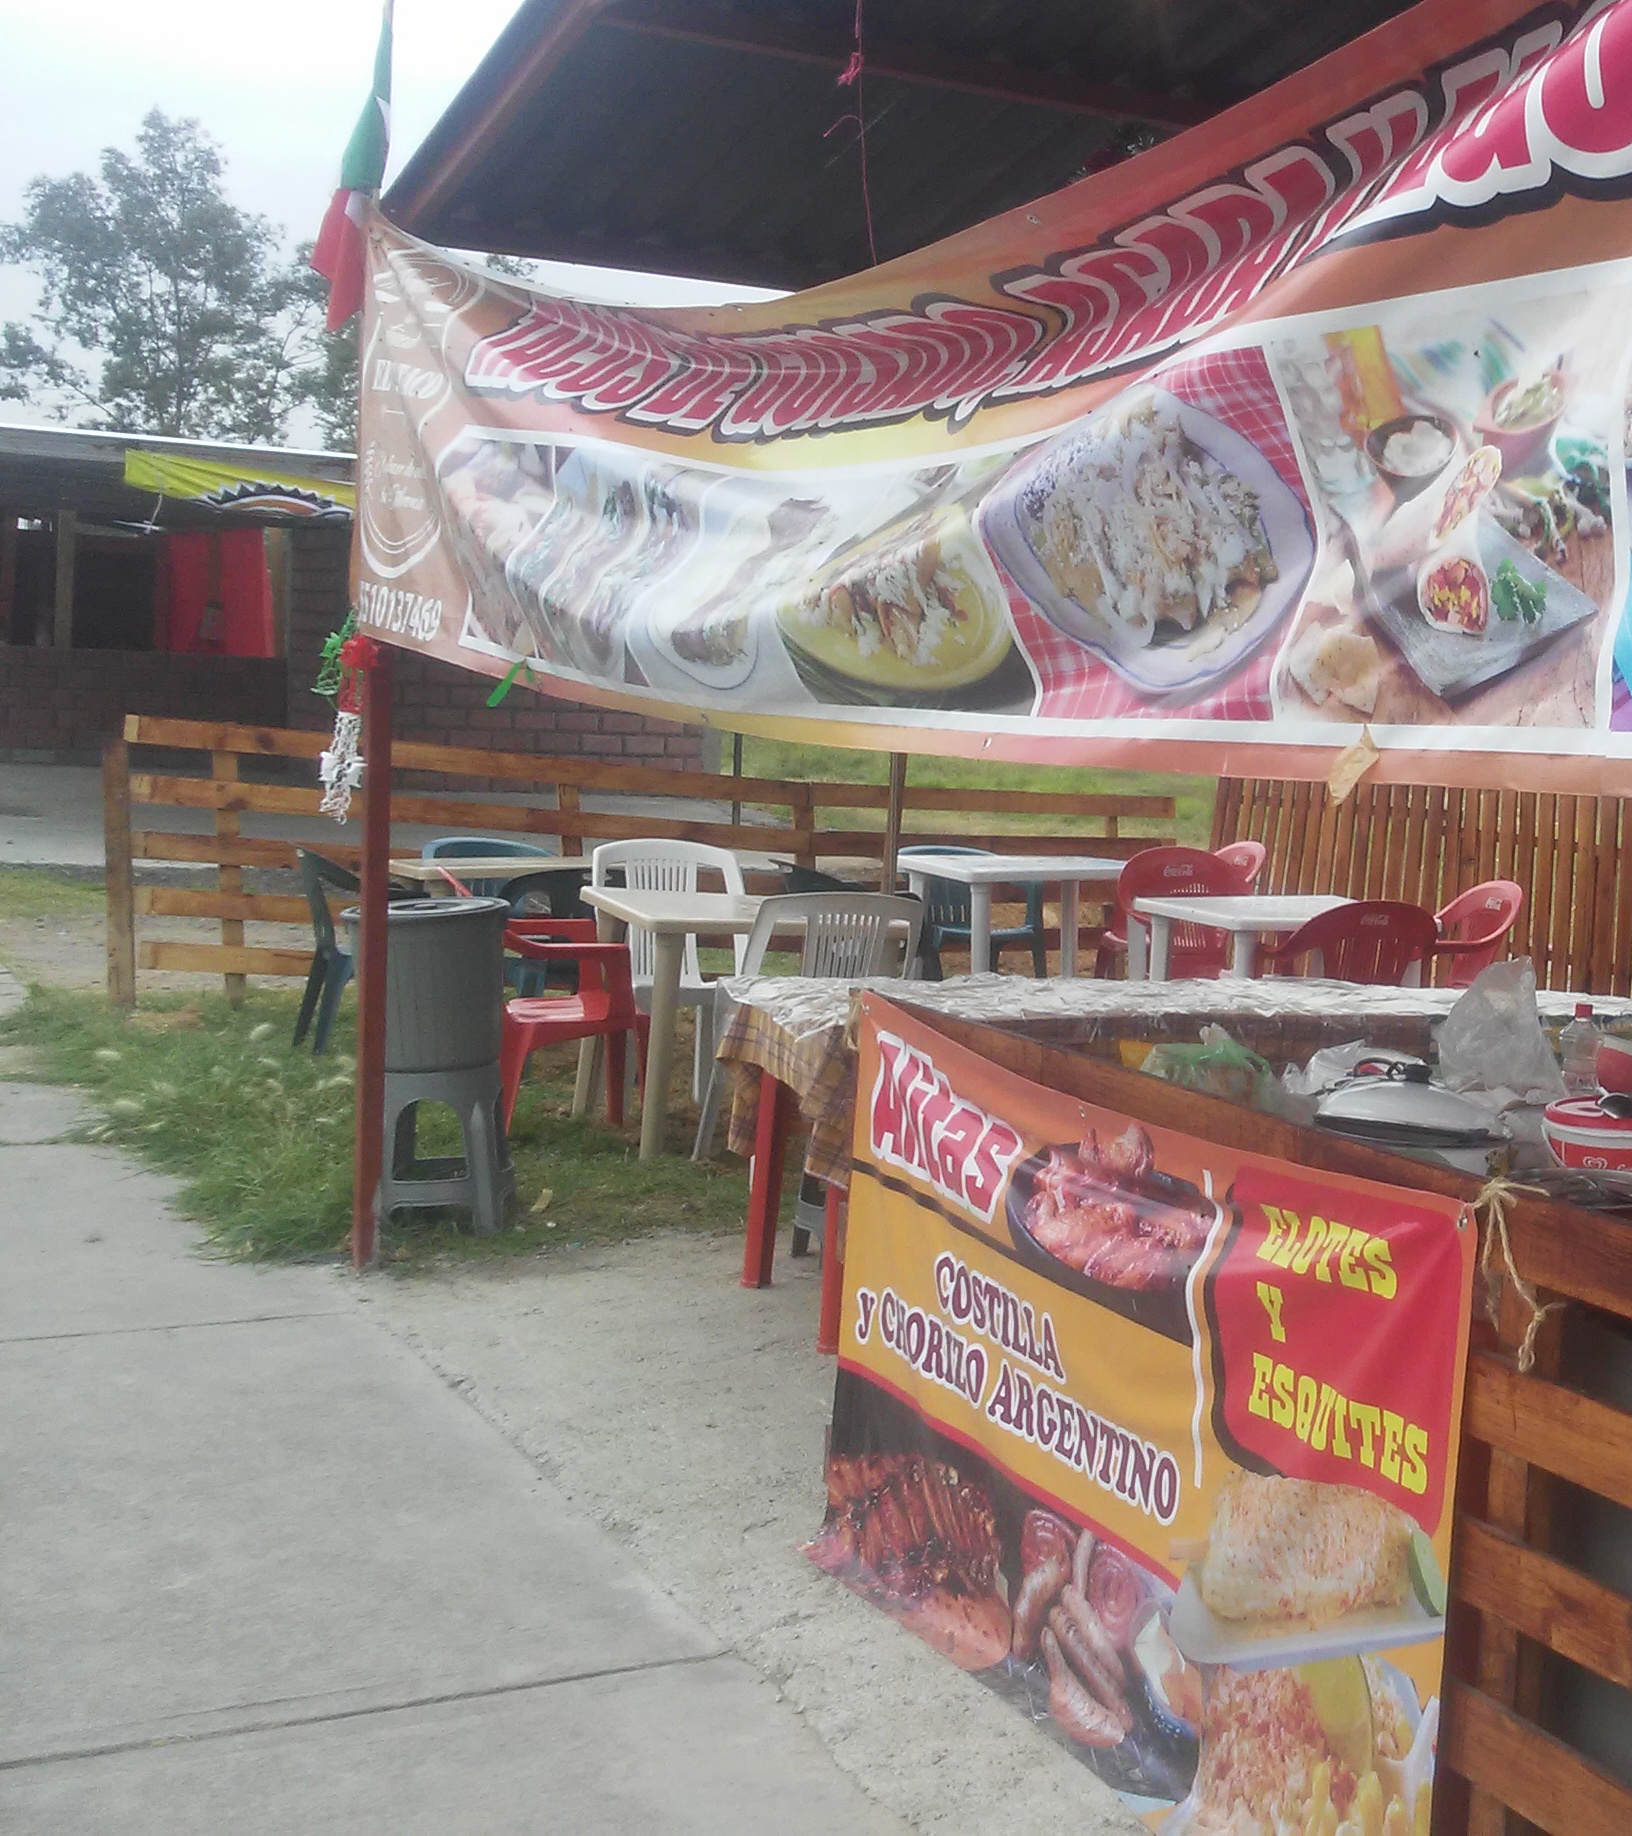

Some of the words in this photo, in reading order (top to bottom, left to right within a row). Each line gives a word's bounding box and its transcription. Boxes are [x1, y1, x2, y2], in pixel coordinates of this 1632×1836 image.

[465, 298, 682, 411] TACOS
[626, 330, 757, 430] DE
[870, 1030, 1024, 1225] Alitas
[934, 1252, 1066, 1383] COSTILLA
[1256, 1203, 1398, 1300] ELOTES
[1256, 1281, 1286, 1343] Y
[880, 1287, 988, 1408] CHORIZO
[986, 1359, 1180, 1524] ARGENTINO
[1249, 1352, 1428, 1494] ESQUITES
